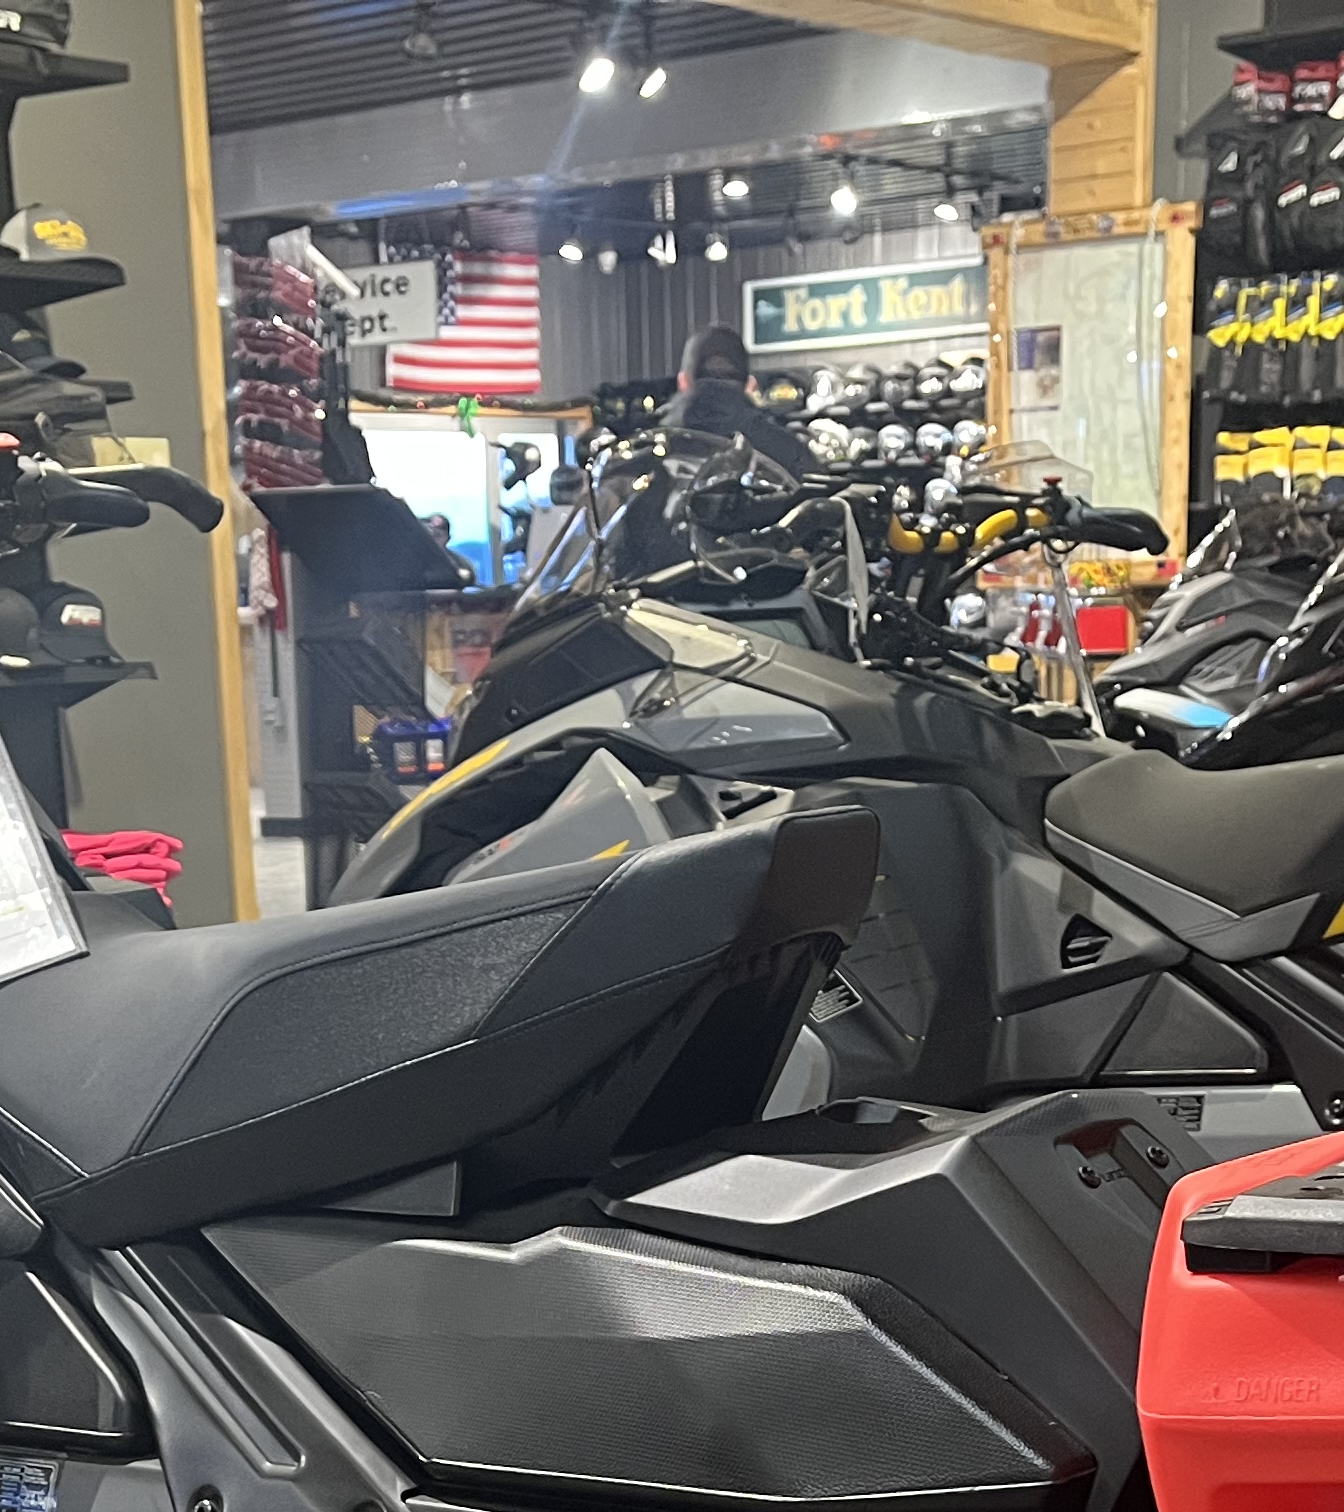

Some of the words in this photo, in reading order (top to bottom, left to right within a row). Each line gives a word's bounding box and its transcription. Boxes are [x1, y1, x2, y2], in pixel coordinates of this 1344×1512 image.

[782, 285, 867, 333] Fort
[878, 273, 966, 323] Kent
[1233, 1378, 1323, 1404] DANGER
